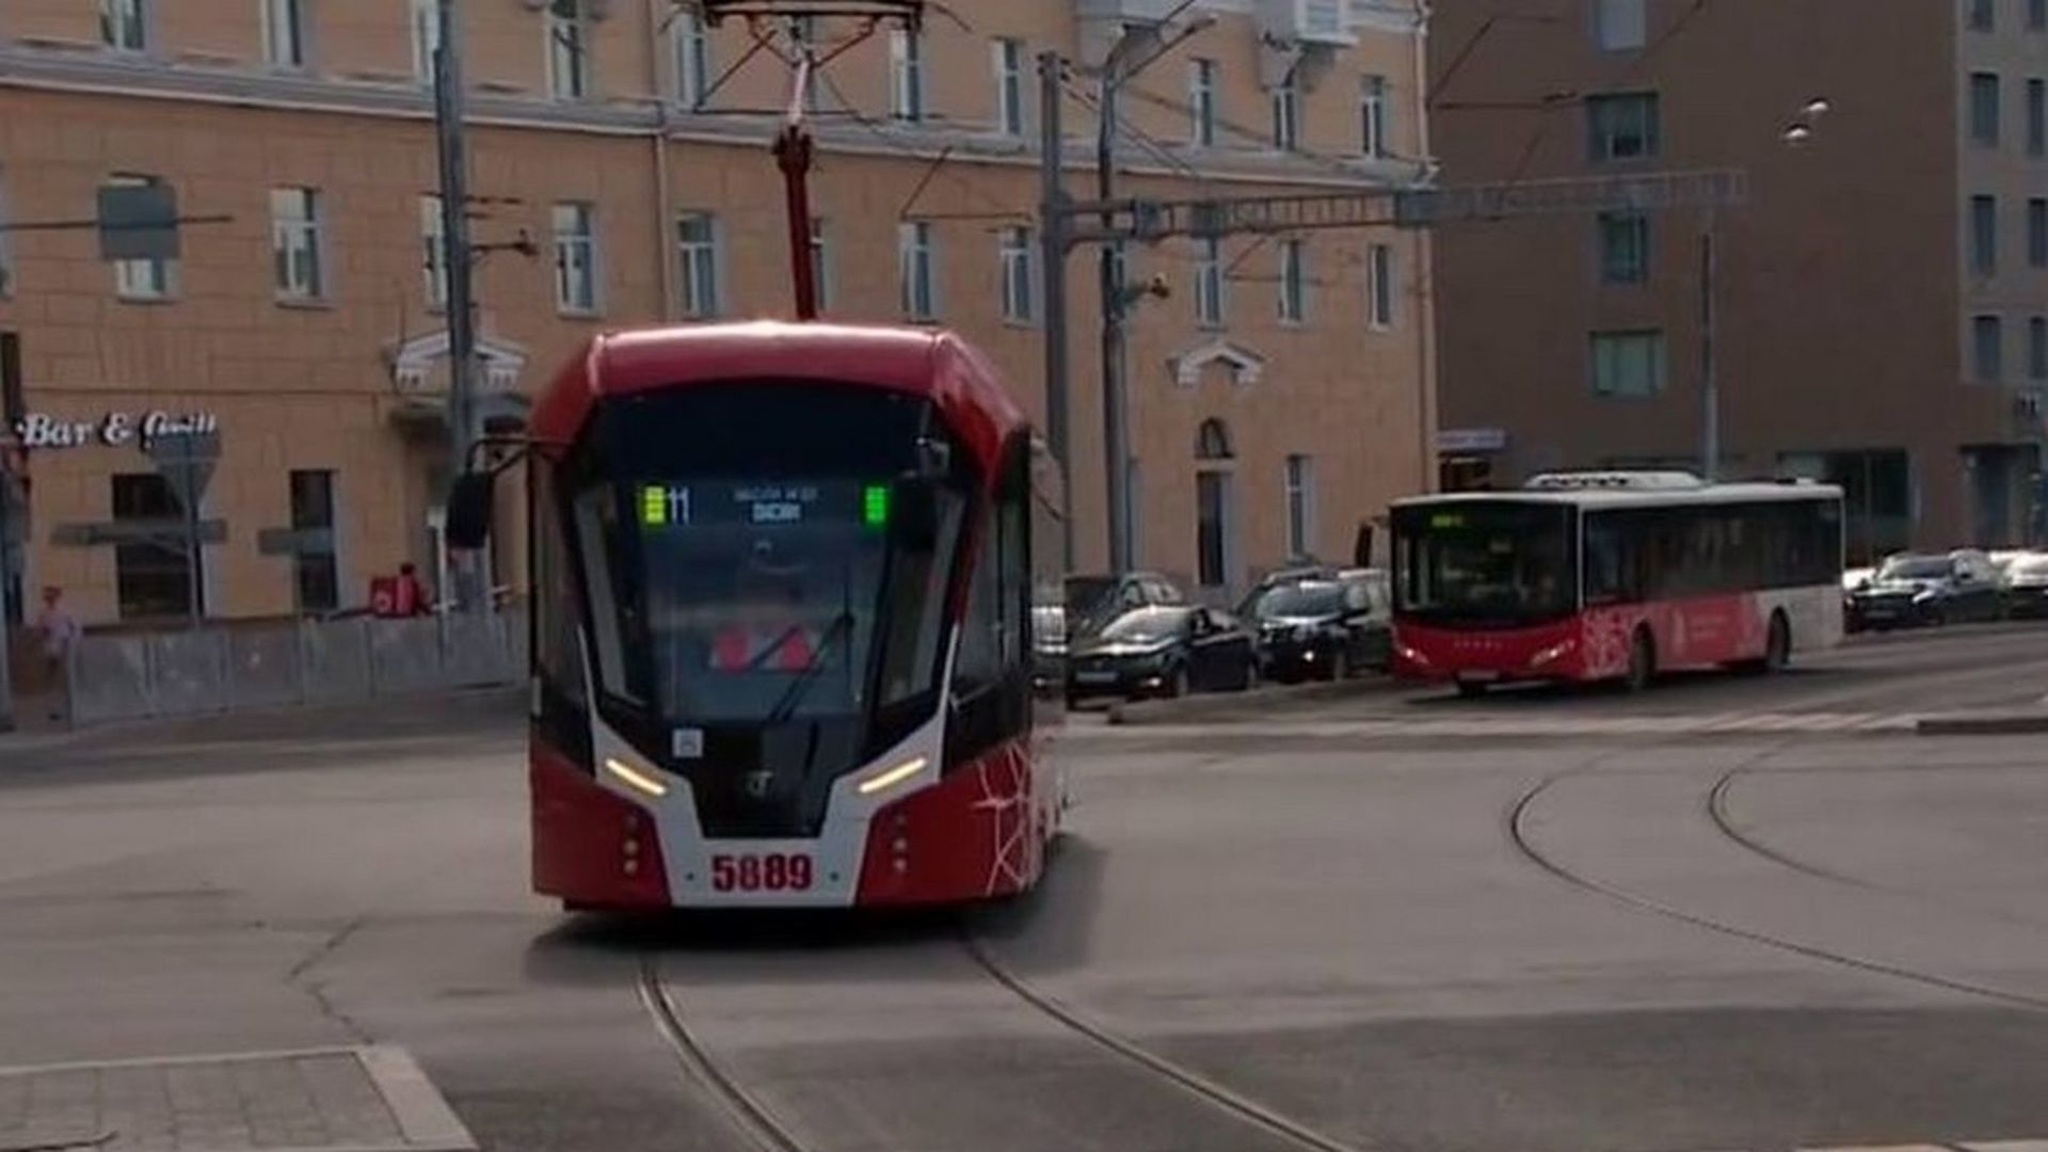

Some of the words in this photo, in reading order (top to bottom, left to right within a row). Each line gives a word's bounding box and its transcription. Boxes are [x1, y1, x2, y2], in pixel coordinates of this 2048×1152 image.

[17, 413, 93, 446] Bar
[103, 412, 131, 443] &
[669, 487, 689, 524] 11
[712, 853, 812, 893] 5889
